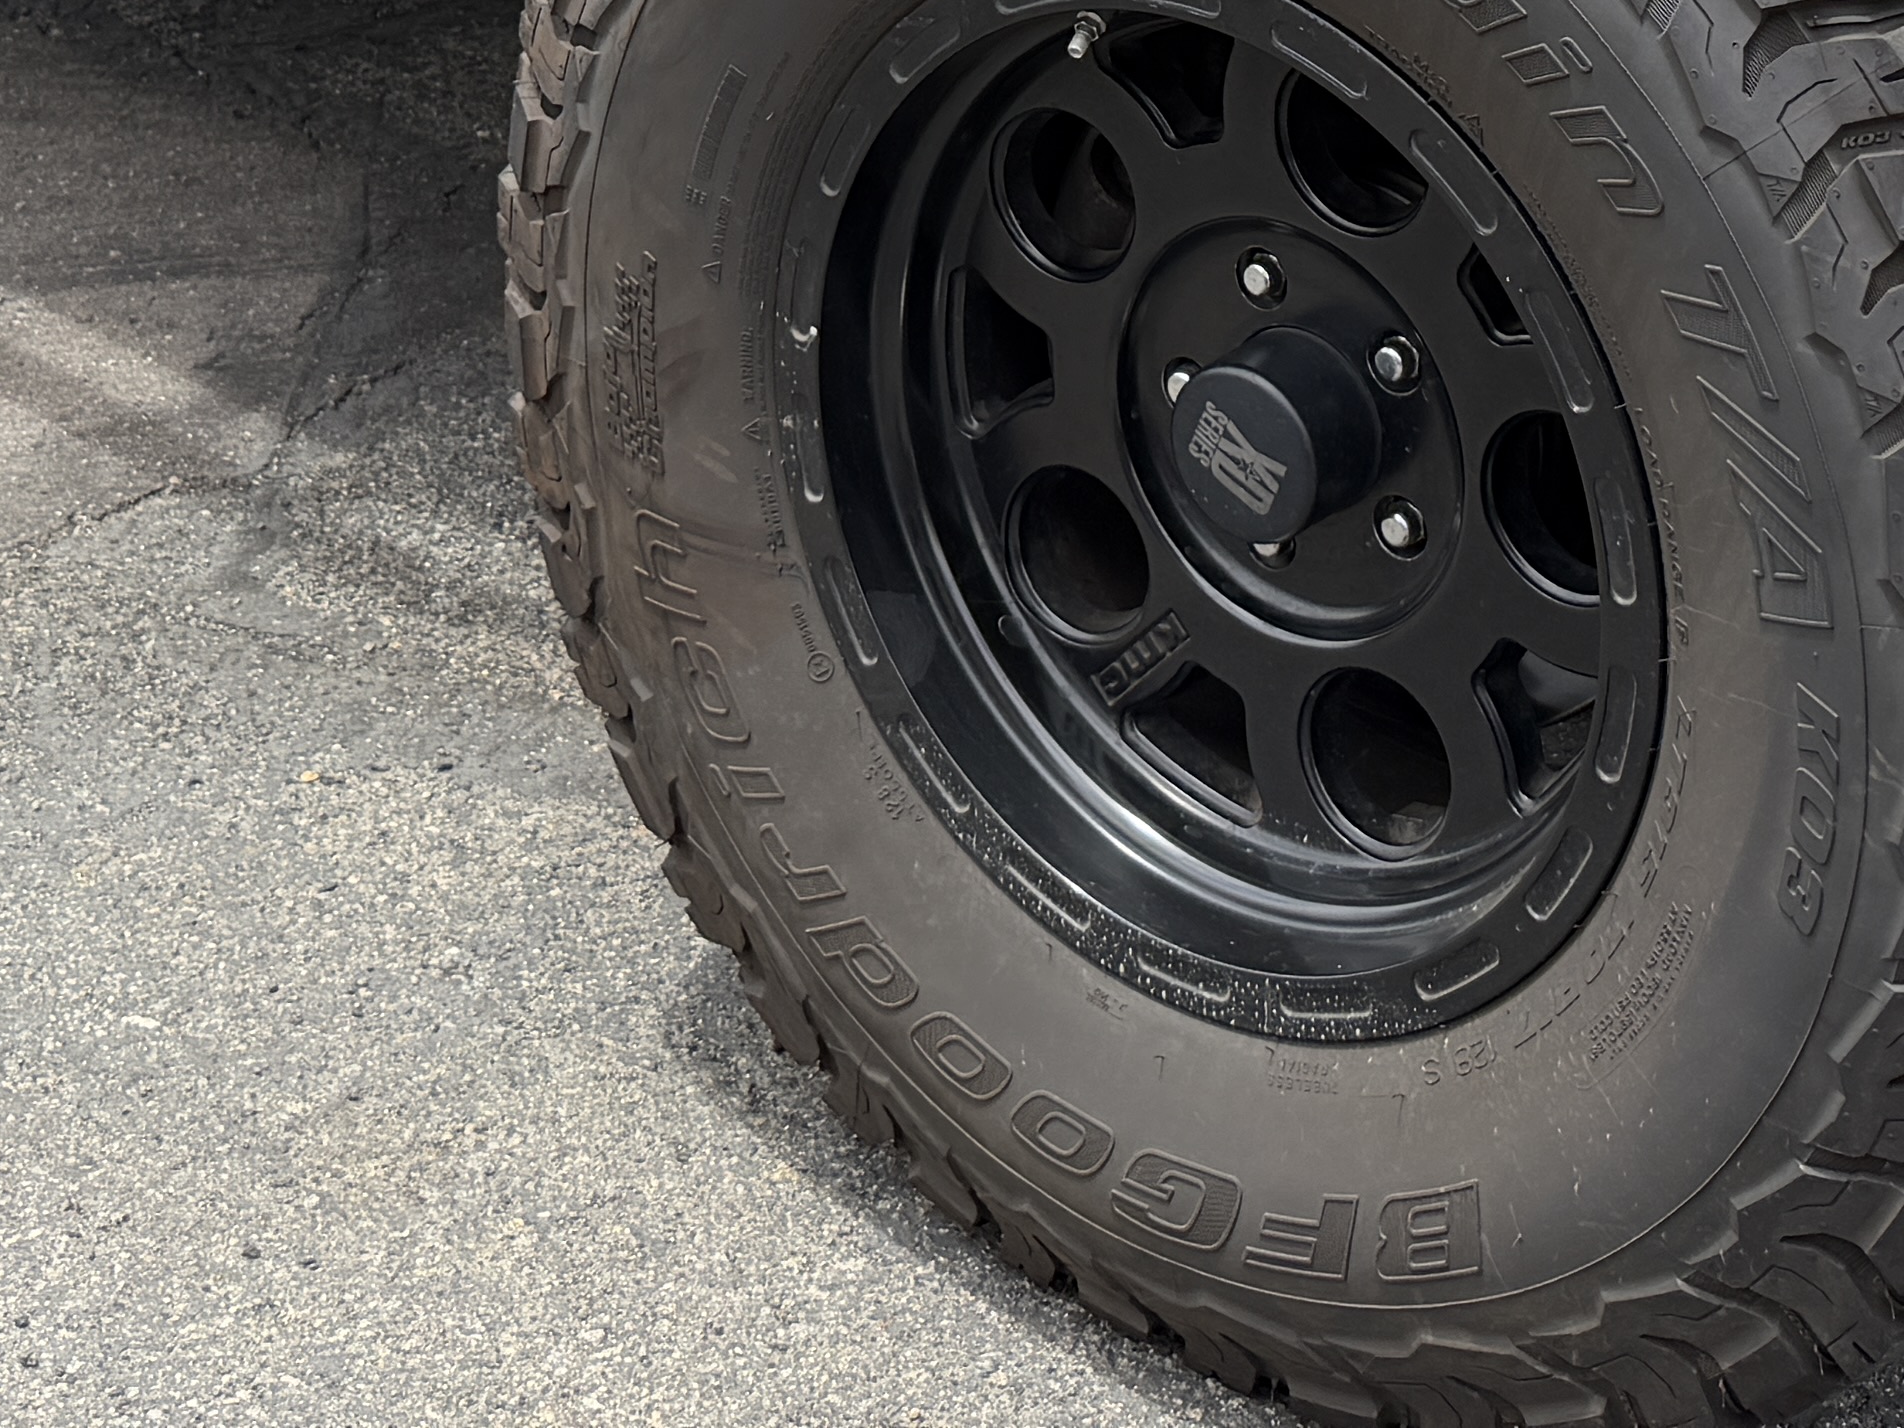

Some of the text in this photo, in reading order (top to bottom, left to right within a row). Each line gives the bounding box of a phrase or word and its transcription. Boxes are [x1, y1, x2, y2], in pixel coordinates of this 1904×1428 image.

[1842, 131, 1892, 148] KO3
[1189, 400, 1229, 467] SERIES
[1662, 263, 1842, 940] T/A KO3
[628, 509, 1488, 1280] BFGoodrich
